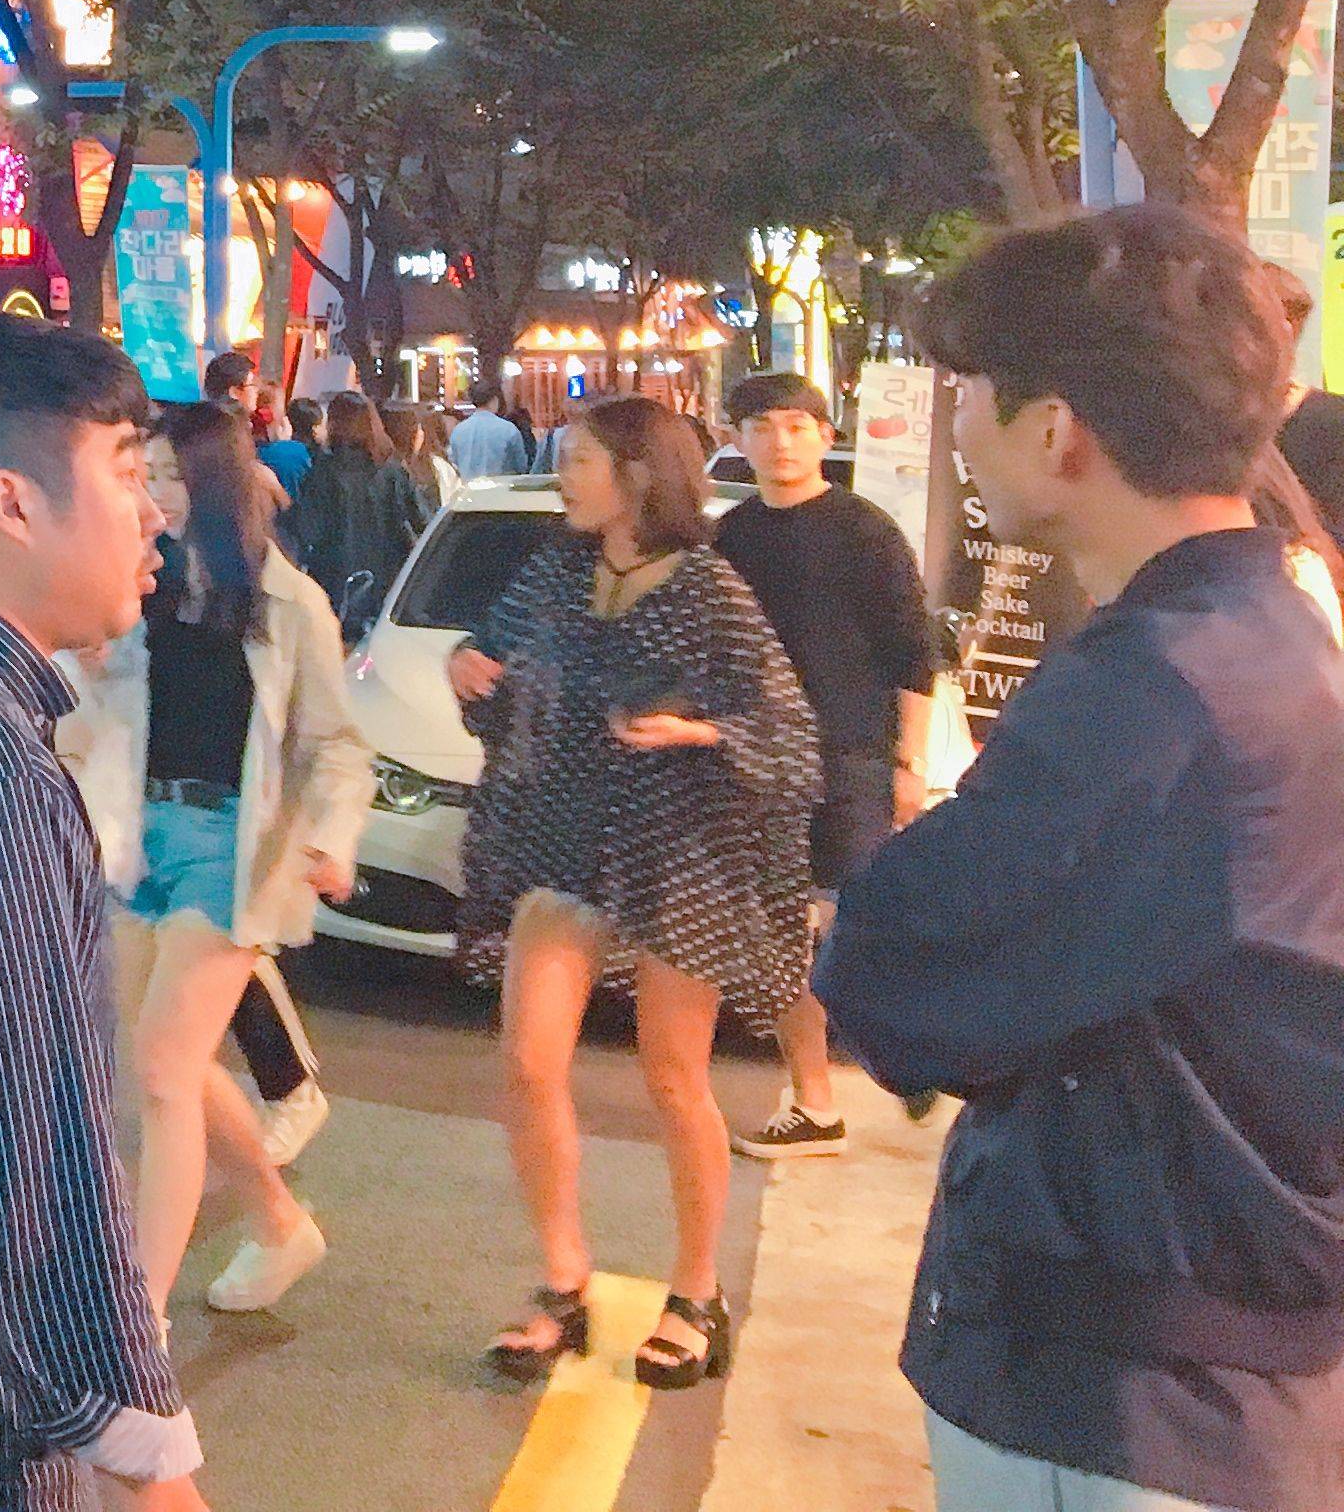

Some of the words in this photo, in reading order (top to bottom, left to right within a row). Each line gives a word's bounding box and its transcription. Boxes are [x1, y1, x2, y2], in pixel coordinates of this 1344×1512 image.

[962, 538, 1054, 574] Whiskey
[983, 565, 1031, 590] Beer
[980, 590, 1030, 615] Sake
